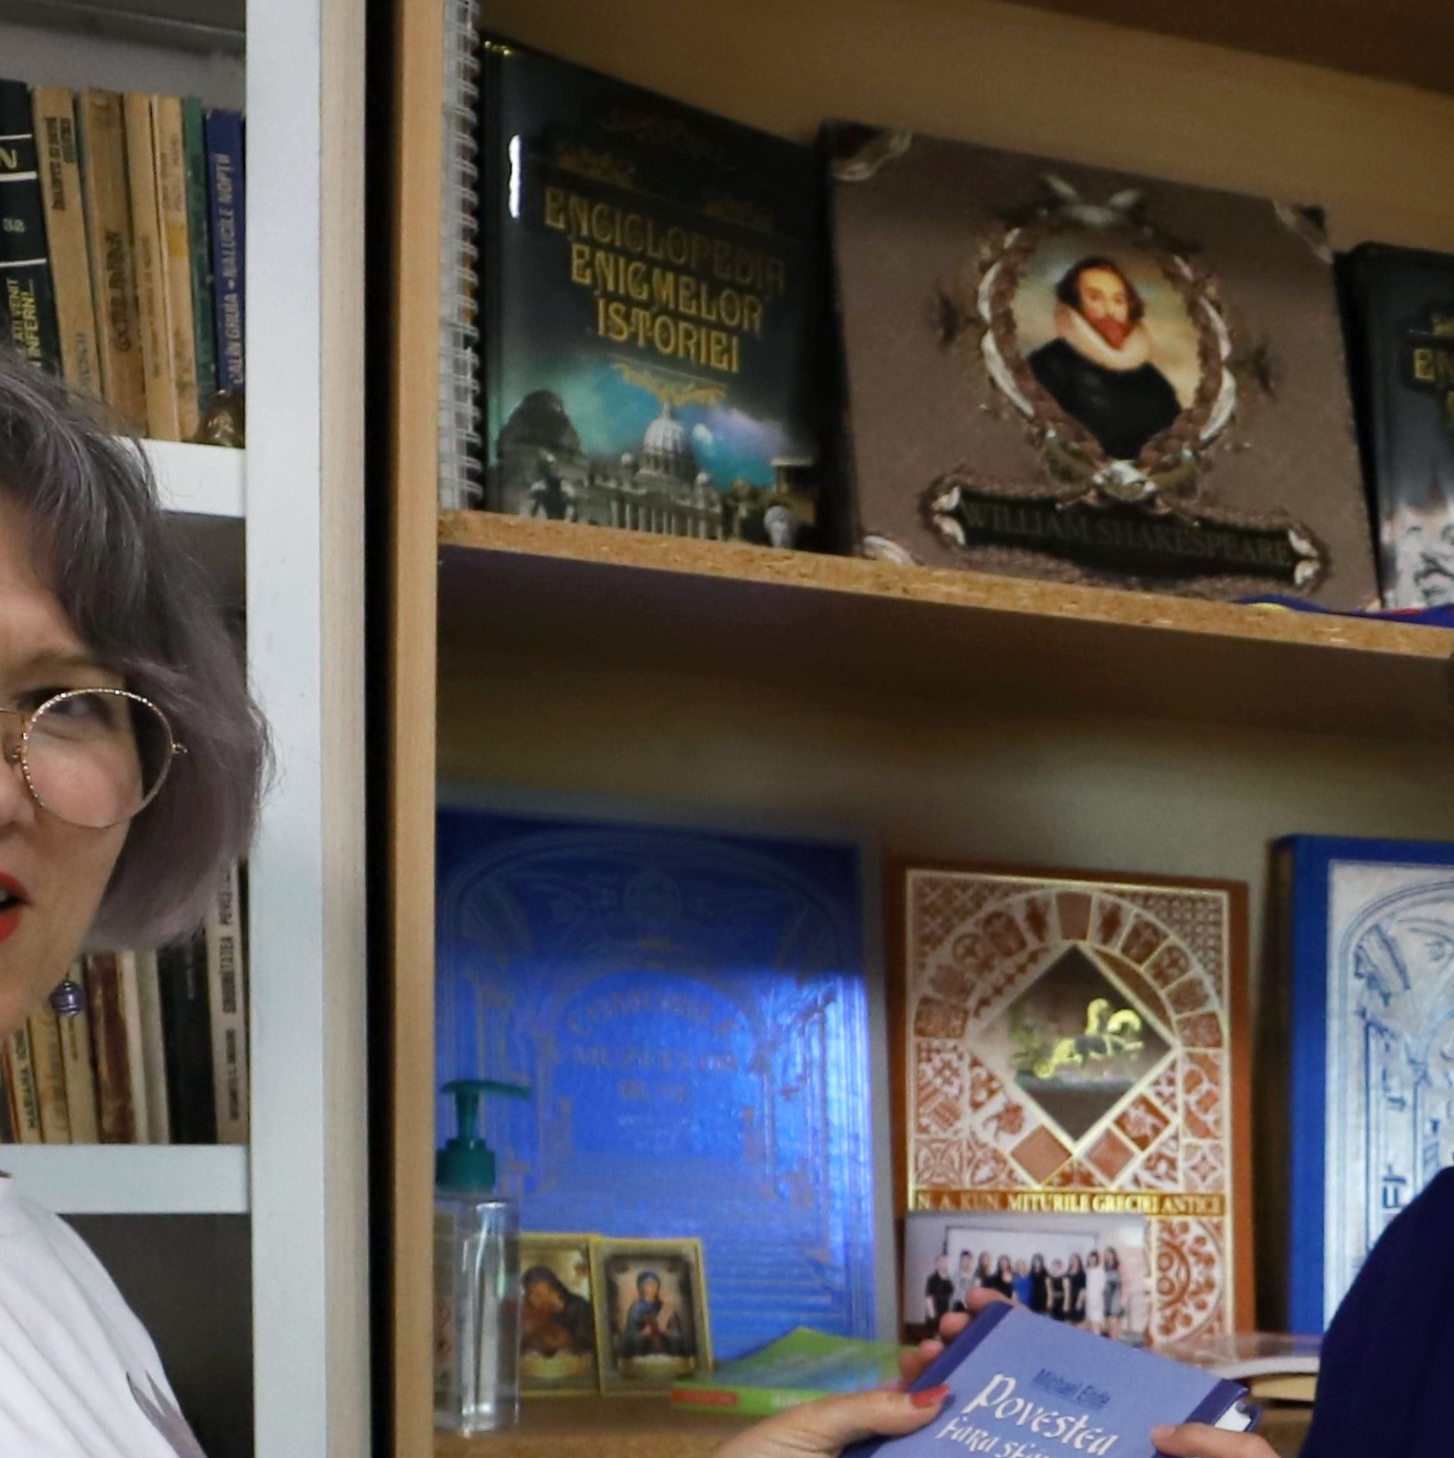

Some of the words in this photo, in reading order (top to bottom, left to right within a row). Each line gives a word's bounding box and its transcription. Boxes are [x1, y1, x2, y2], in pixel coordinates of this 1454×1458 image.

[544, 186, 785, 296] ENCICLOPEDIA
[571, 243, 767, 338] ENIGMELOR
[595, 297, 742, 374] ISTORIEI
[1007, 1193, 1090, 1213] MITURILE
[961, 1373, 1119, 1456] Povestea
